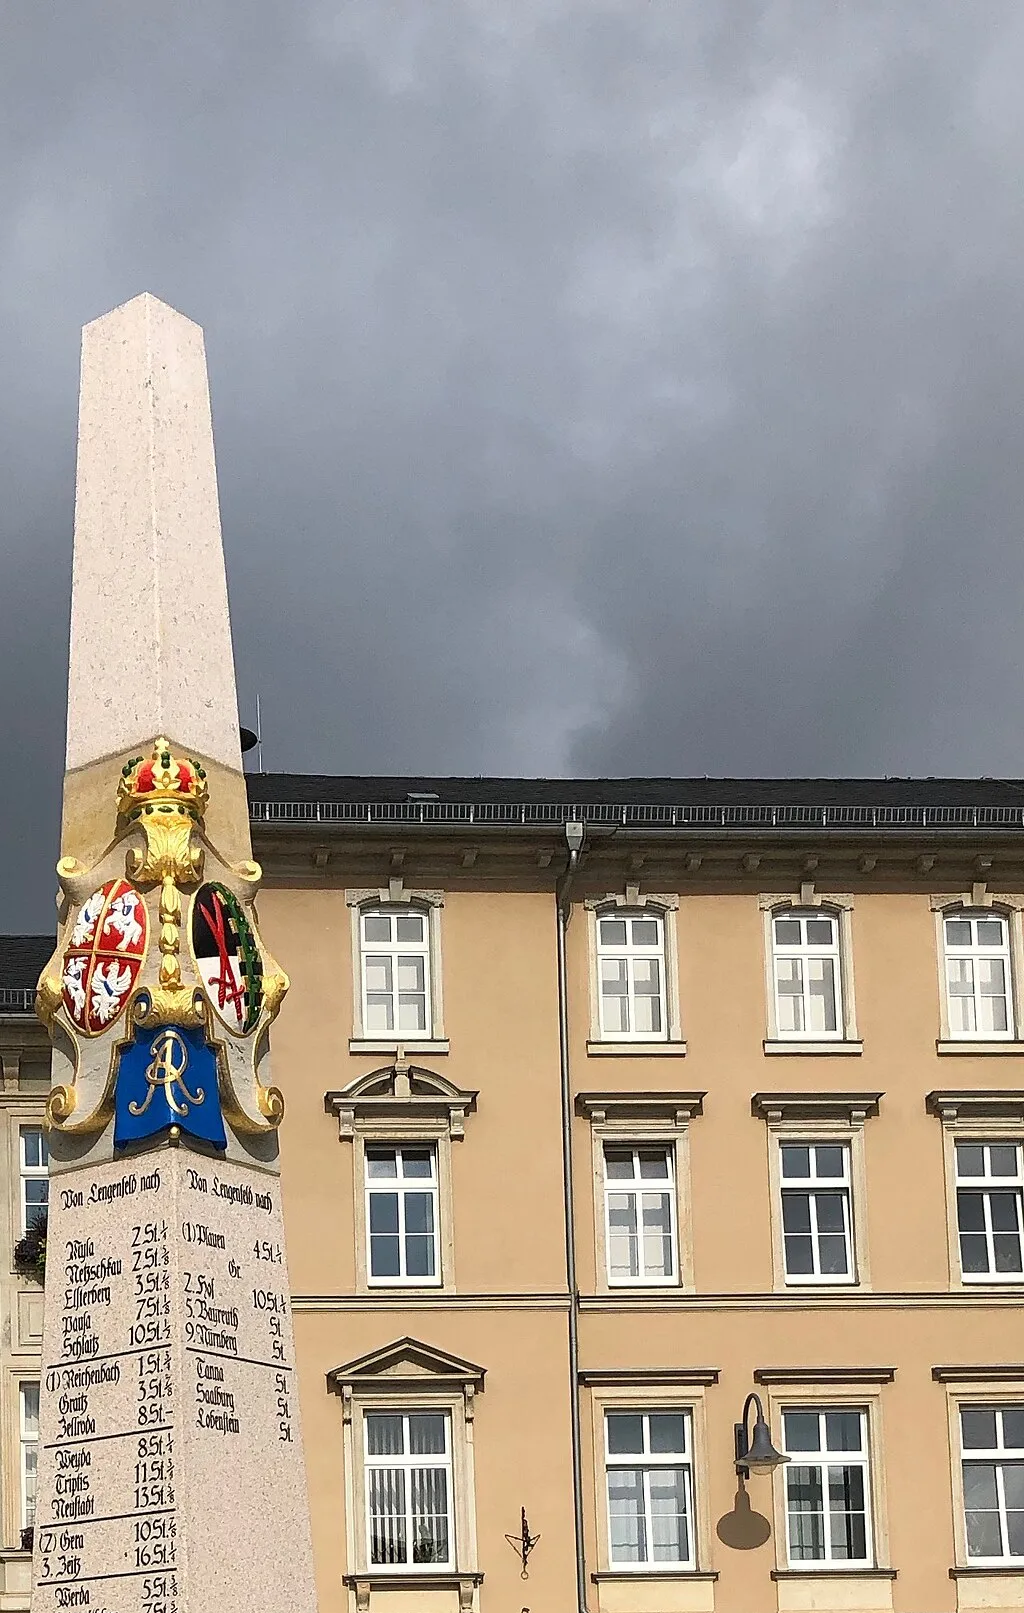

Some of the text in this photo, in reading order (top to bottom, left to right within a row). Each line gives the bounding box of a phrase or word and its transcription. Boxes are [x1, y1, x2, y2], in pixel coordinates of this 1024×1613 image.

[60, 1168, 161, 1210] Von Lengenfeld nach
[186, 1168, 273, 1215] Von Lengenfeld nach
[195, 1224, 226, 1250] Plauen
[65, 1257, 122, 1286] Netzschkau
[195, 1299, 239, 1332] Bayreuth
[46, 1371, 61, 1392] (1)
[62, 1360, 120, 1392] Reichenbach
[195, 1356, 224, 1382] Tanna
[195, 1383, 235, 1413] Saalburg
[39, 1533, 57, 1553] (2)
[60, 1529, 84, 1552] Gera
[41, 1557, 54, 1578] 3.
[56, 1555, 81, 1581] Zeitz
[55, 1585, 90, 1608] Werda
